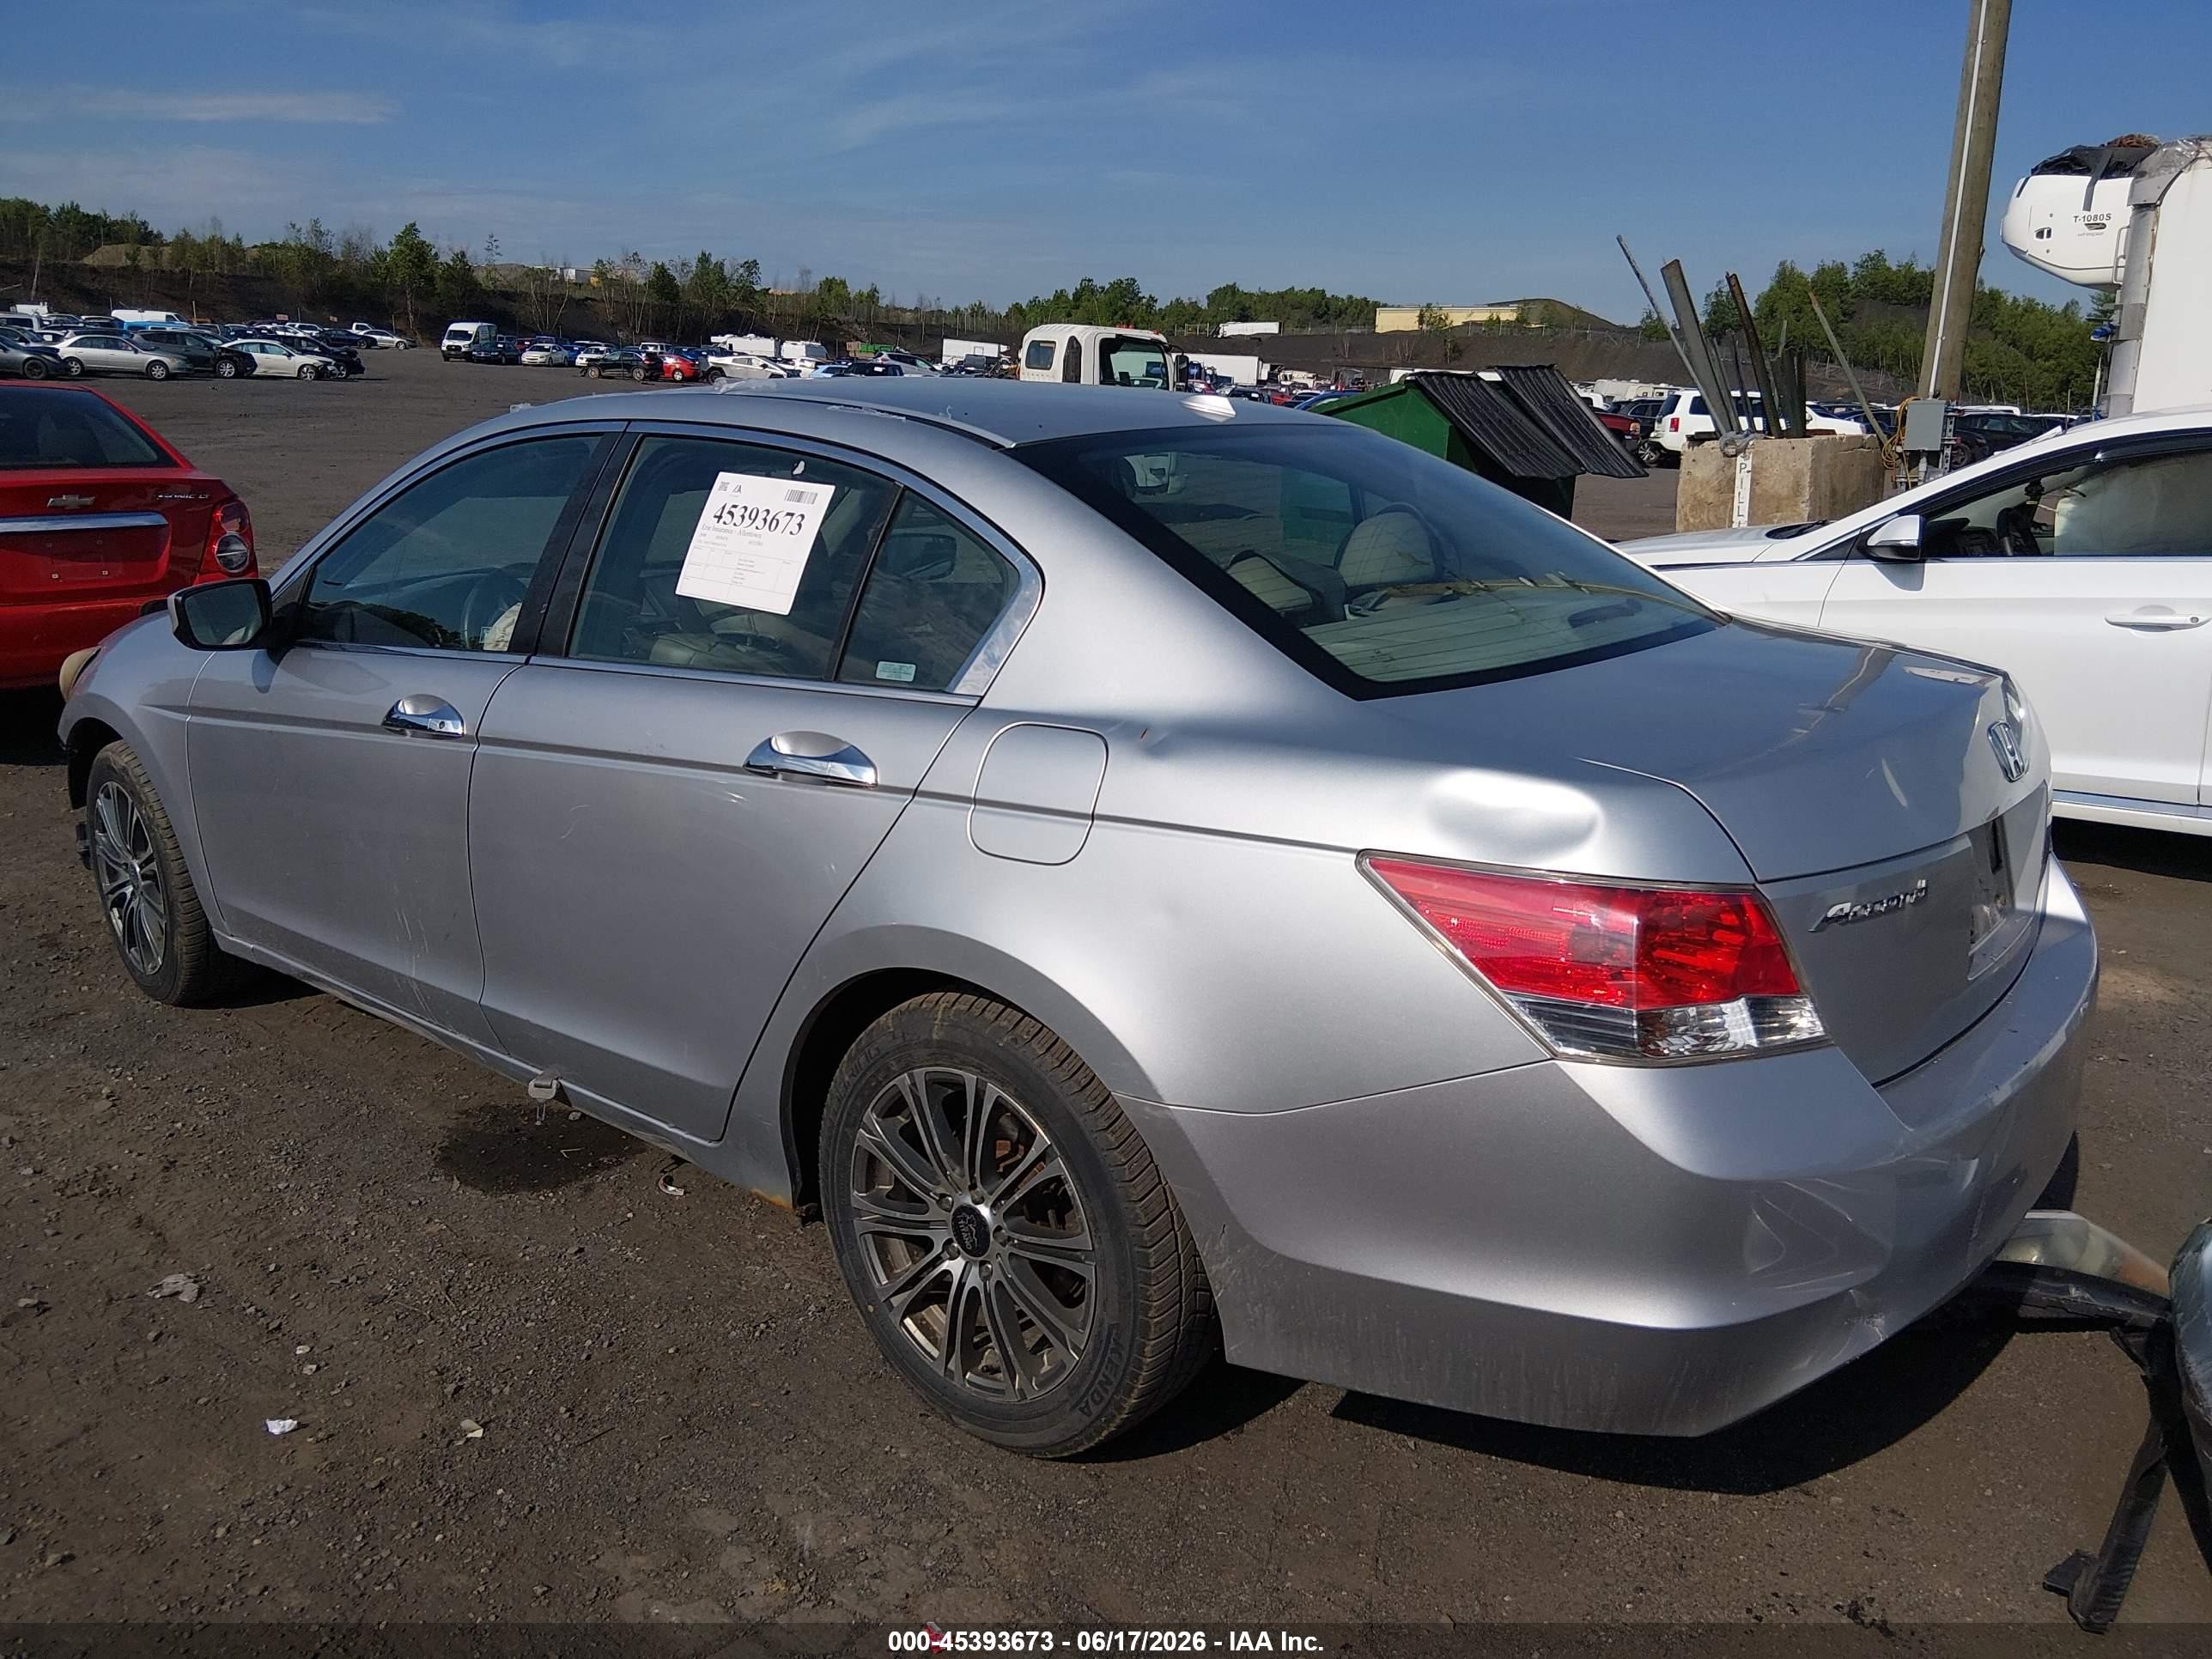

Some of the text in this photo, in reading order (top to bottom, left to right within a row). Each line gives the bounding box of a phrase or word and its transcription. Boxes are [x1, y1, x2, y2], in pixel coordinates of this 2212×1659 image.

[2073, 213, 2112, 222] T-1080S
[713, 502, 805, 536] 45393673
[1808, 879, 1926, 933] Accord
